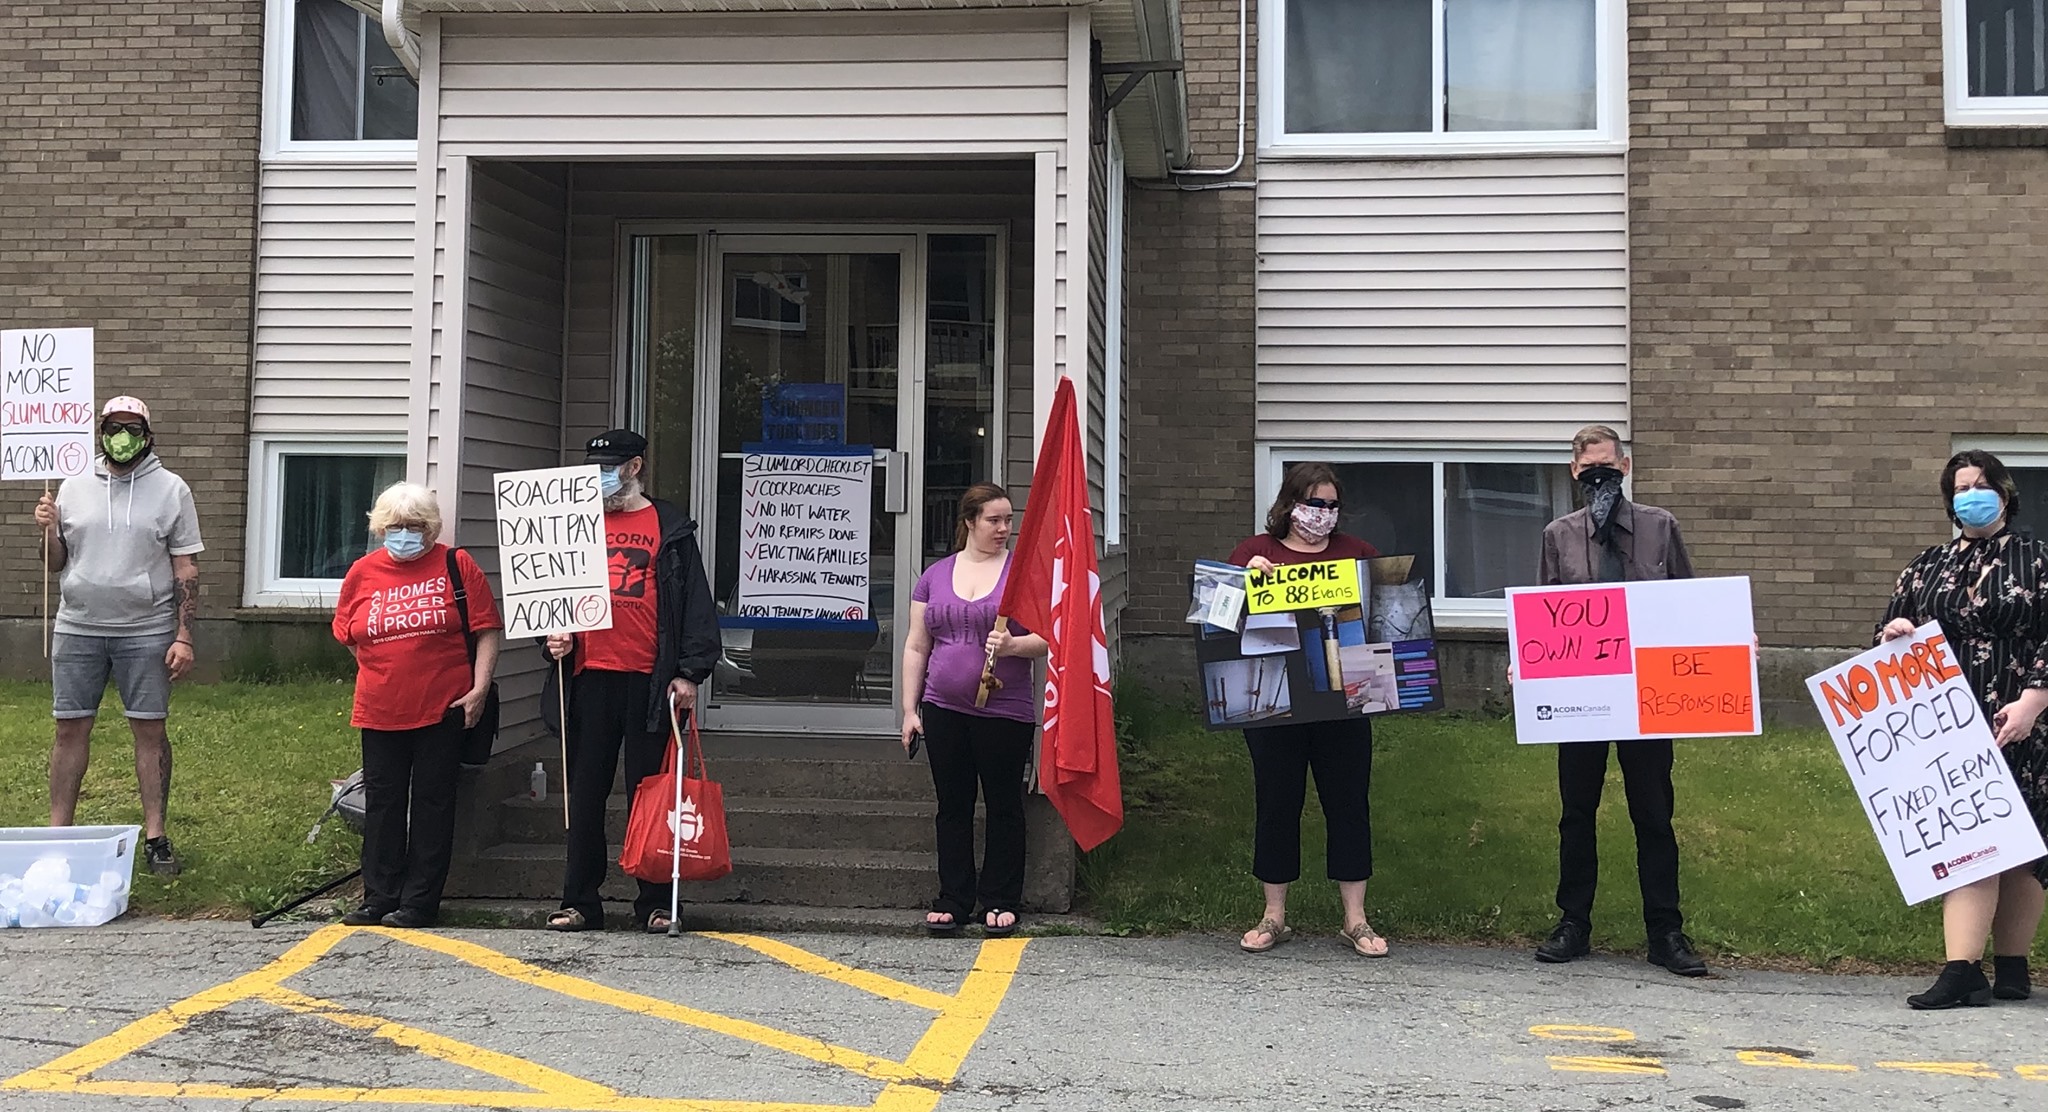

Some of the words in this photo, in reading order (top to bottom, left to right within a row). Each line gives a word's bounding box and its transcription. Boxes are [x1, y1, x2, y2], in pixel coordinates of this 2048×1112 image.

[20, 333, 56, 364] NO
[6, 367, 73, 395] MORE
[2, 401, 92, 427] SLUMLORDS
[1, 444, 54, 474] ACORN
[745, 454, 815, 473] SLUMLORD
[815, 457, 871, 475] CHECKLIST
[498, 476, 598, 510] ROACHES
[760, 480, 841, 496] COCKROACHES
[760, 501, 776, 517] NO
[781, 503, 804, 519] HOT
[808, 505, 851, 523] WATER
[500, 516, 563, 547] DON'T
[567, 513, 600, 545] PAY
[606, 532, 655, 547] CORN
[759, 523, 775, 539] NO
[780, 525, 825, 539] REPAIRS
[829, 528, 859, 541] DONE
[758, 543, 815, 562] EVICTING
[817, 547, 868, 565] FAMILIES
[511, 551, 587, 585] RENT!
[758, 568, 817, 584] HARASSING
[820, 572, 868, 587] TENANTS
[1249, 564, 1339, 588] WELCOME
[387, 577, 446, 601] HOMES
[1252, 593, 1274, 606] TO
[1286, 585, 1309, 604] 88
[1312, 585, 1353, 600] Evans
[367, 590, 381, 637] ACORN
[386, 596, 445, 613] OVER
[509, 597, 575, 633] ACORN
[740, 604, 769, 617] ACORN
[772, 606, 813, 618] TENANTS
[1543, 596, 1609, 628] YOU
[384, 610, 447, 633] PROFIT
[1521, 636, 1582, 665] OWN
[1594, 637, 1626, 660] IT
[1672, 651, 1712, 676] BE
[1819, 664, 1879, 727] NO
[1874, 633, 1962, 705] MORE
[1640, 687, 1752, 716] RESPONSIBLE
[1847, 687, 1975, 776] FORCED
[1869, 787, 1937, 836] FIXED
[1925, 748, 2002, 796] TERM
[1899, 780, 2012, 858] LEASES
[1947, 853, 1972, 868] ACORN
